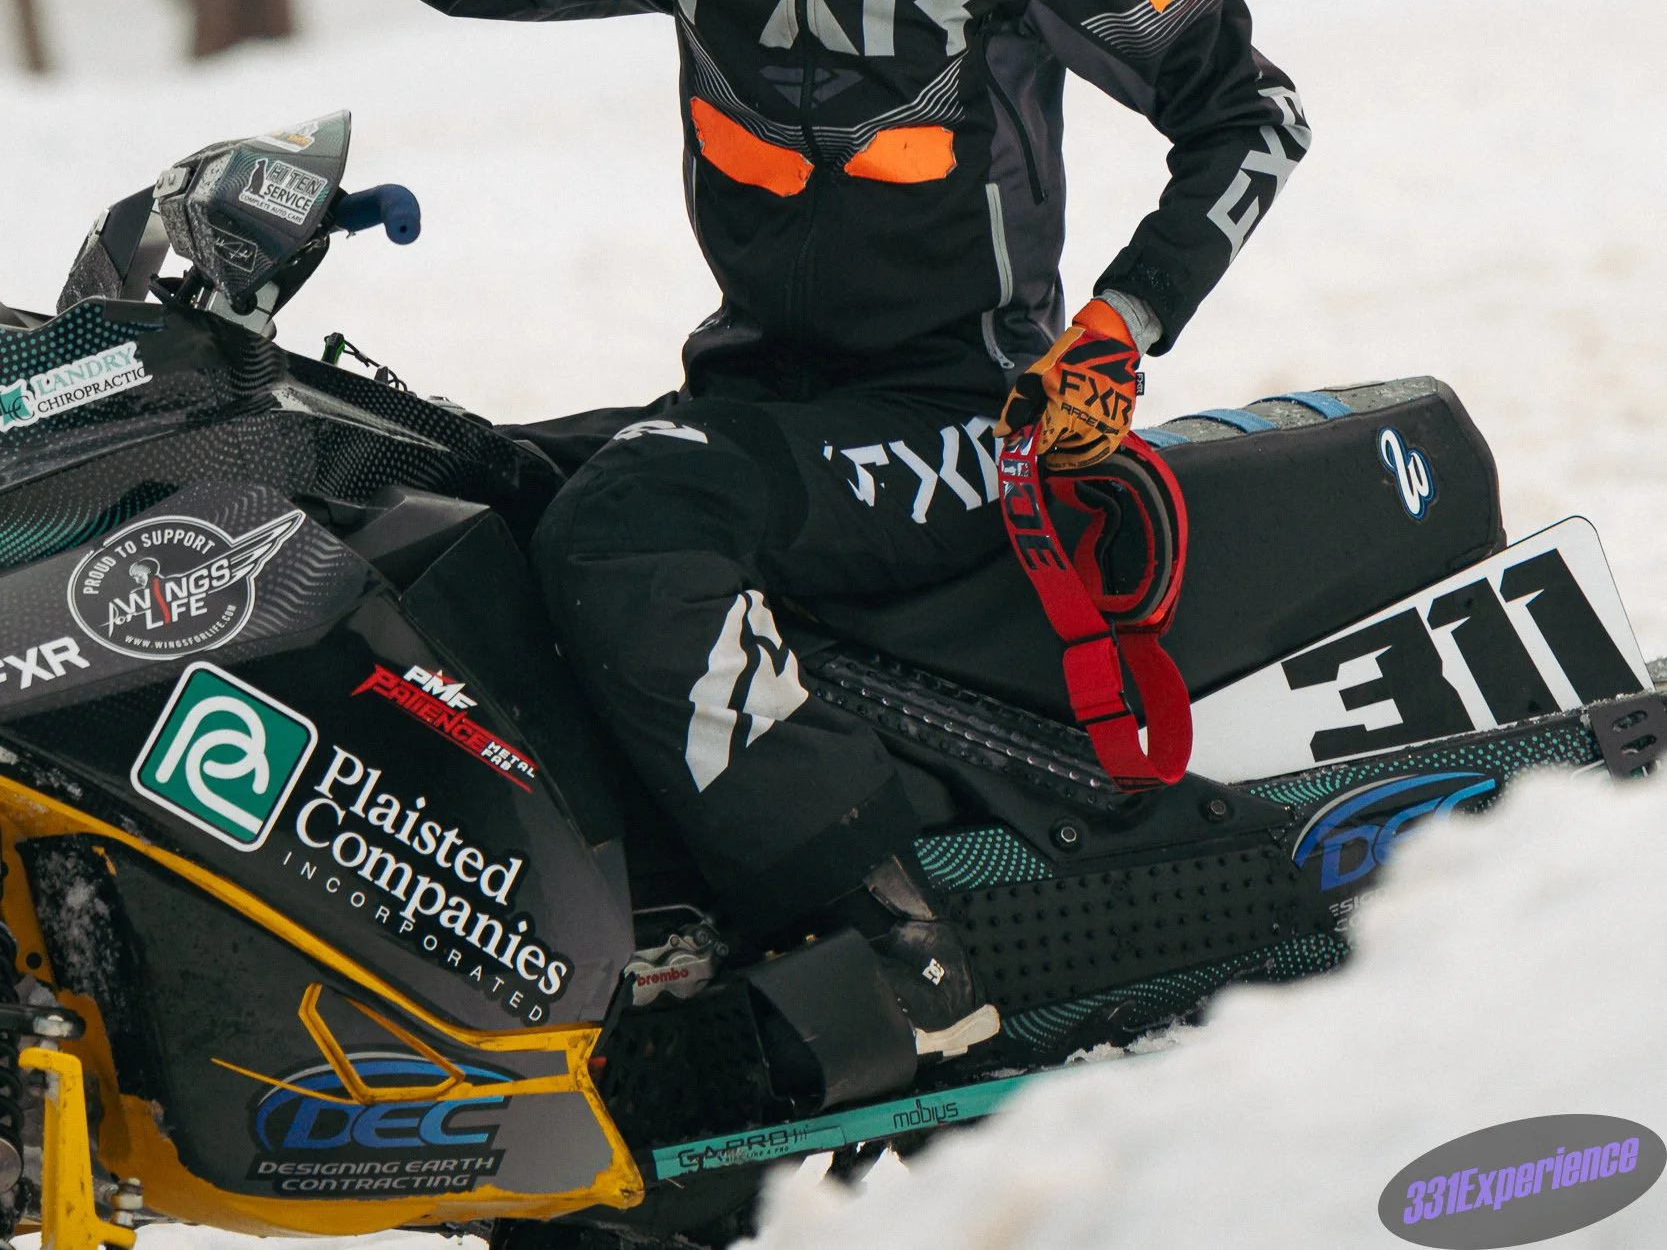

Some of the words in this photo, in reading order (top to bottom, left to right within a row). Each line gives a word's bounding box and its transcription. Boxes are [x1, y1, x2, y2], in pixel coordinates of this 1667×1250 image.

[264, 184, 312, 211] SERVICE
[266, 161, 293, 184] HI
[286, 168, 324, 197] TEN
[240, 193, 270, 209] COMPLETE
[272, 207, 287, 217] AUTO
[287, 213, 303, 223] CARE
[36, 346, 132, 395] LANDRY
[37, 366, 146, 414] CHIROPRACTIC
[1136, 372, 1144, 394] FXR
[1059, 369, 1132, 426] FXR
[1061, 402, 1098, 427] RACE
[83, 555, 117, 594] PROUD
[115, 540, 137, 558] TO
[141, 529, 216, 554] SUPPORT
[113, 558, 231, 616] WINGS
[125, 604, 237, 649] WWW.WINGSFORLIFE.COM
[145, 593, 208, 630] LIFE
[0, 636, 90, 690] XR
[1281, 548, 1645, 763] 311
[352, 664, 492, 751] PATIENCE
[403, 665, 478, 710] PMF
[481, 748, 512, 771] FAB
[487, 741, 536, 778] METAL
[314, 745, 523, 906] Plaisted
[296, 798, 567, 995] Companies
[283, 852, 543, 1022] INCORPORATED
[636, 967, 689, 987] brembo
[280, 1095, 505, 1148] DEC
[257, 1160, 400, 1176] DESIGNING
[405, 1157, 495, 1173] EARTH
[280, 1173, 471, 1191] CONTRACTING
